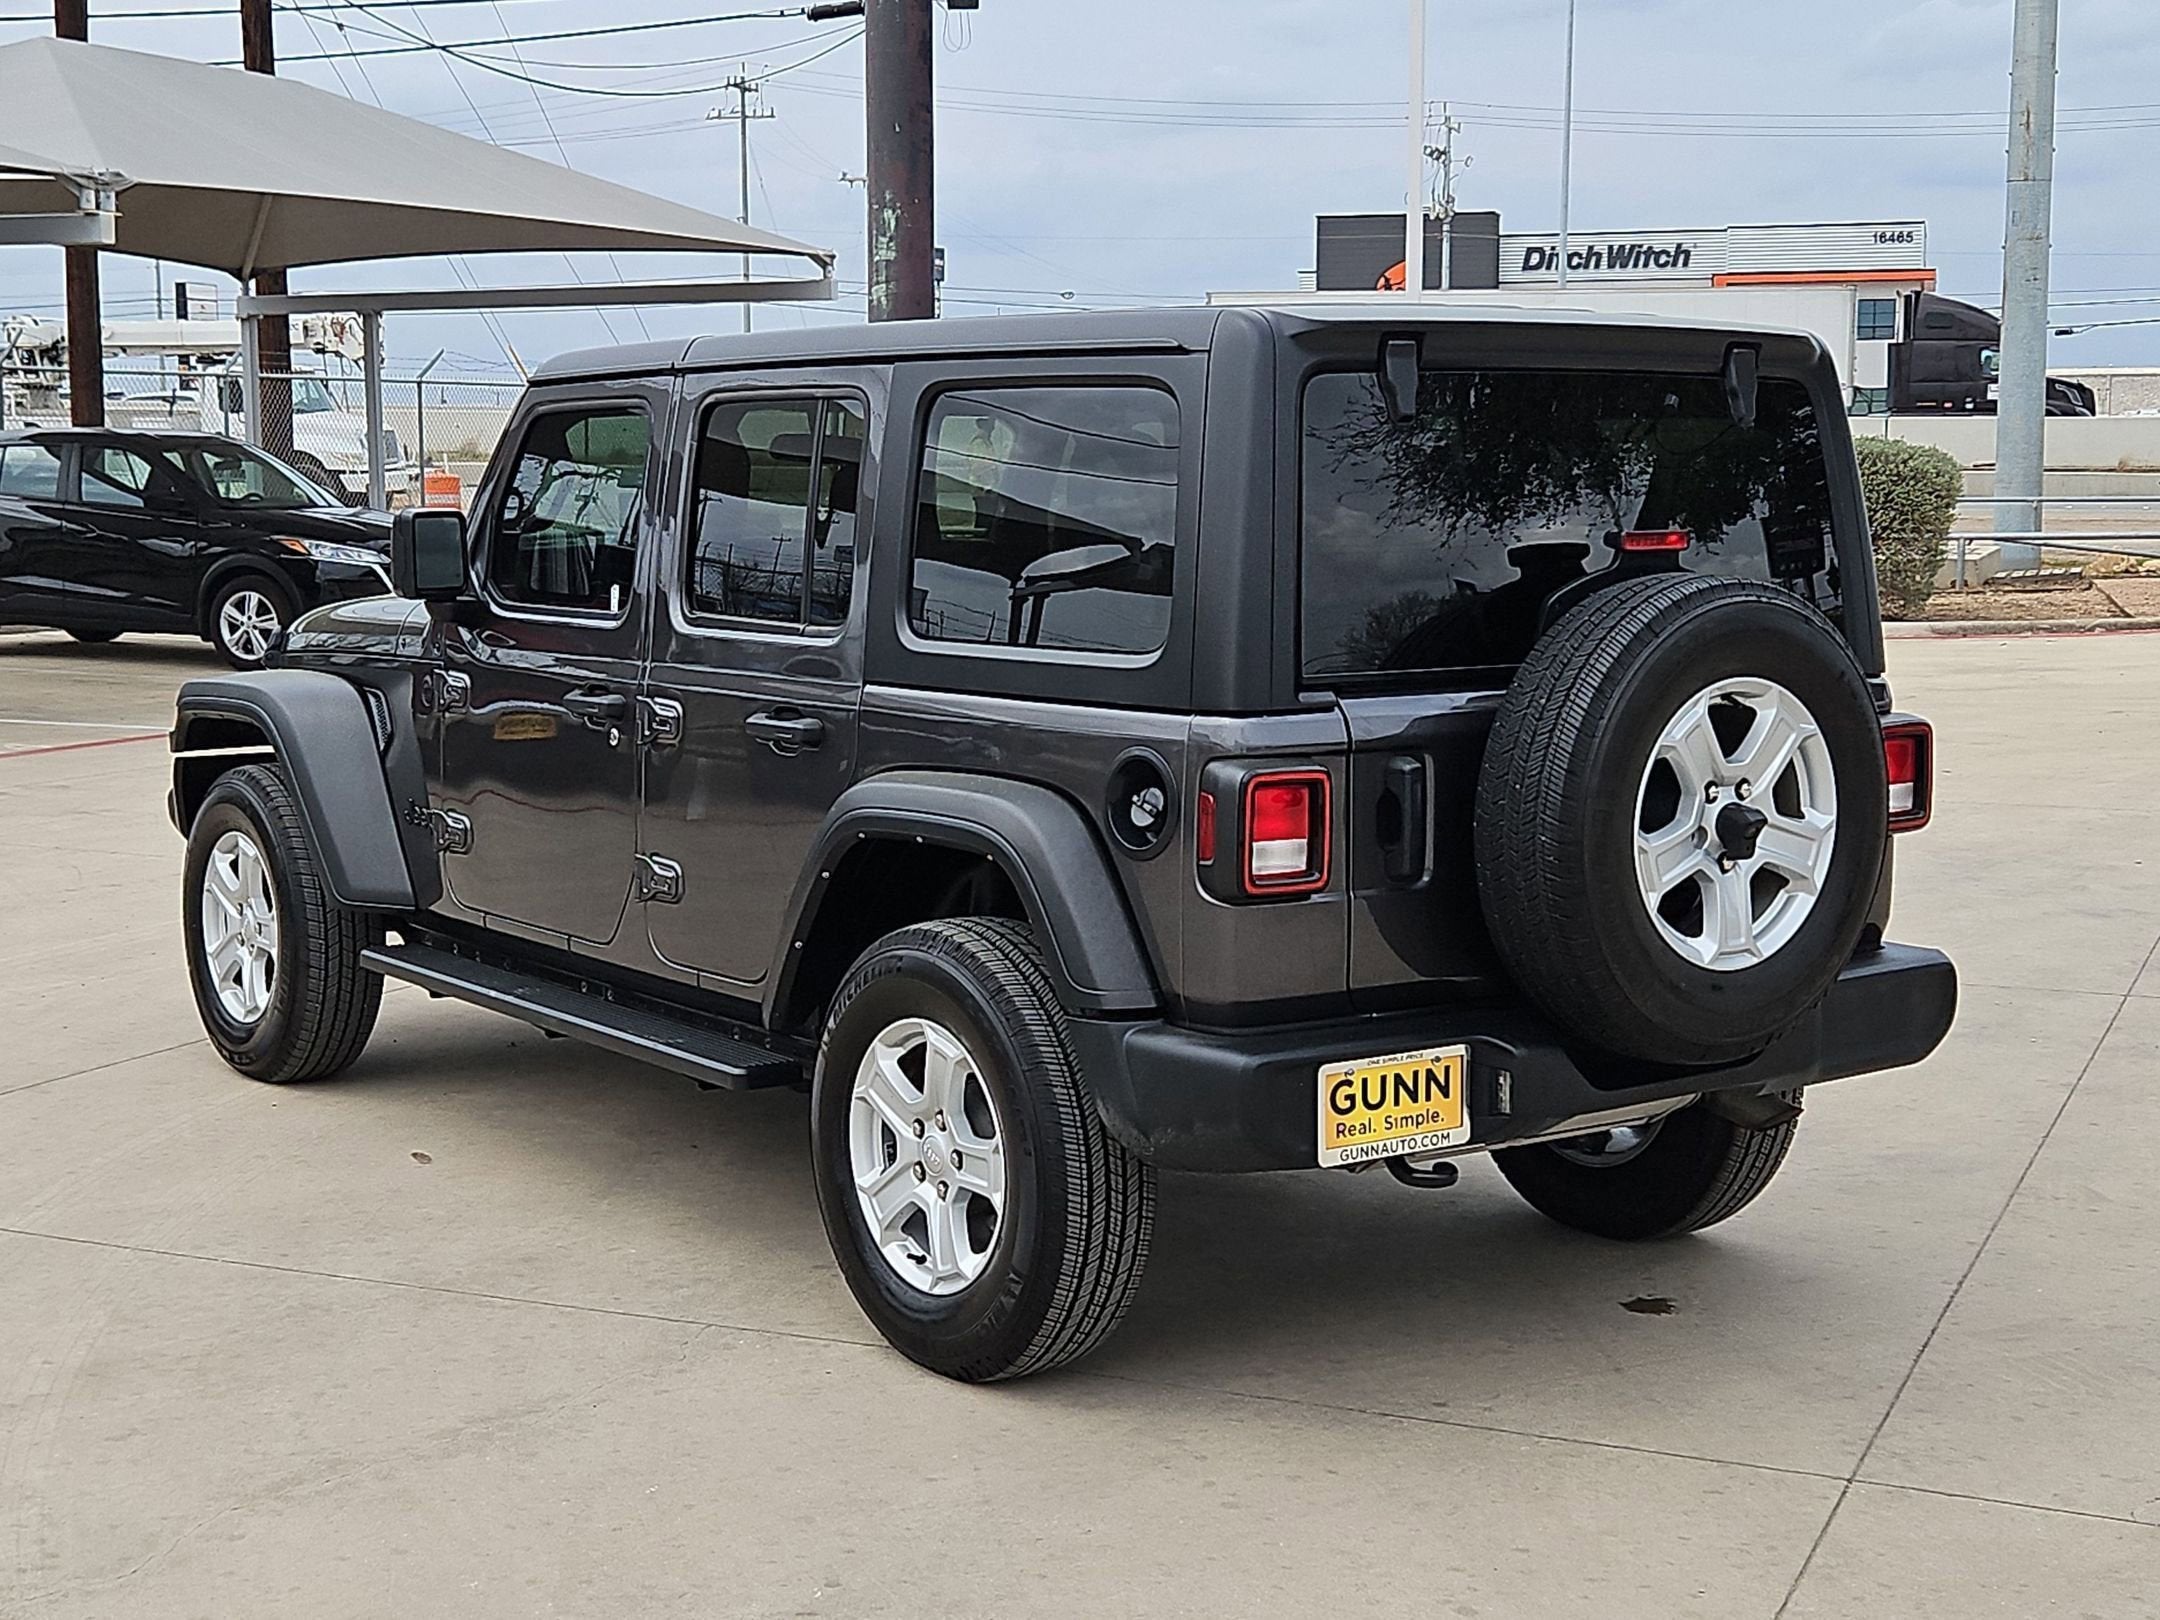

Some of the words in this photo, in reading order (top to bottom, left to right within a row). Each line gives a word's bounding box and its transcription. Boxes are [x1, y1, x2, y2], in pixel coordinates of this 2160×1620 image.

[1872, 231, 1914, 244] 16465
[1606, 243, 1691, 269] Witch
[1382, 1055, 1404, 1064] SIMPLE
[1330, 1065, 1450, 1115] GUNN
[1335, 1117, 1377, 1139] Real.
[1384, 1108, 1445, 1130] Simple.
[1340, 1132, 1451, 1162] GUNNAUTO.COM
